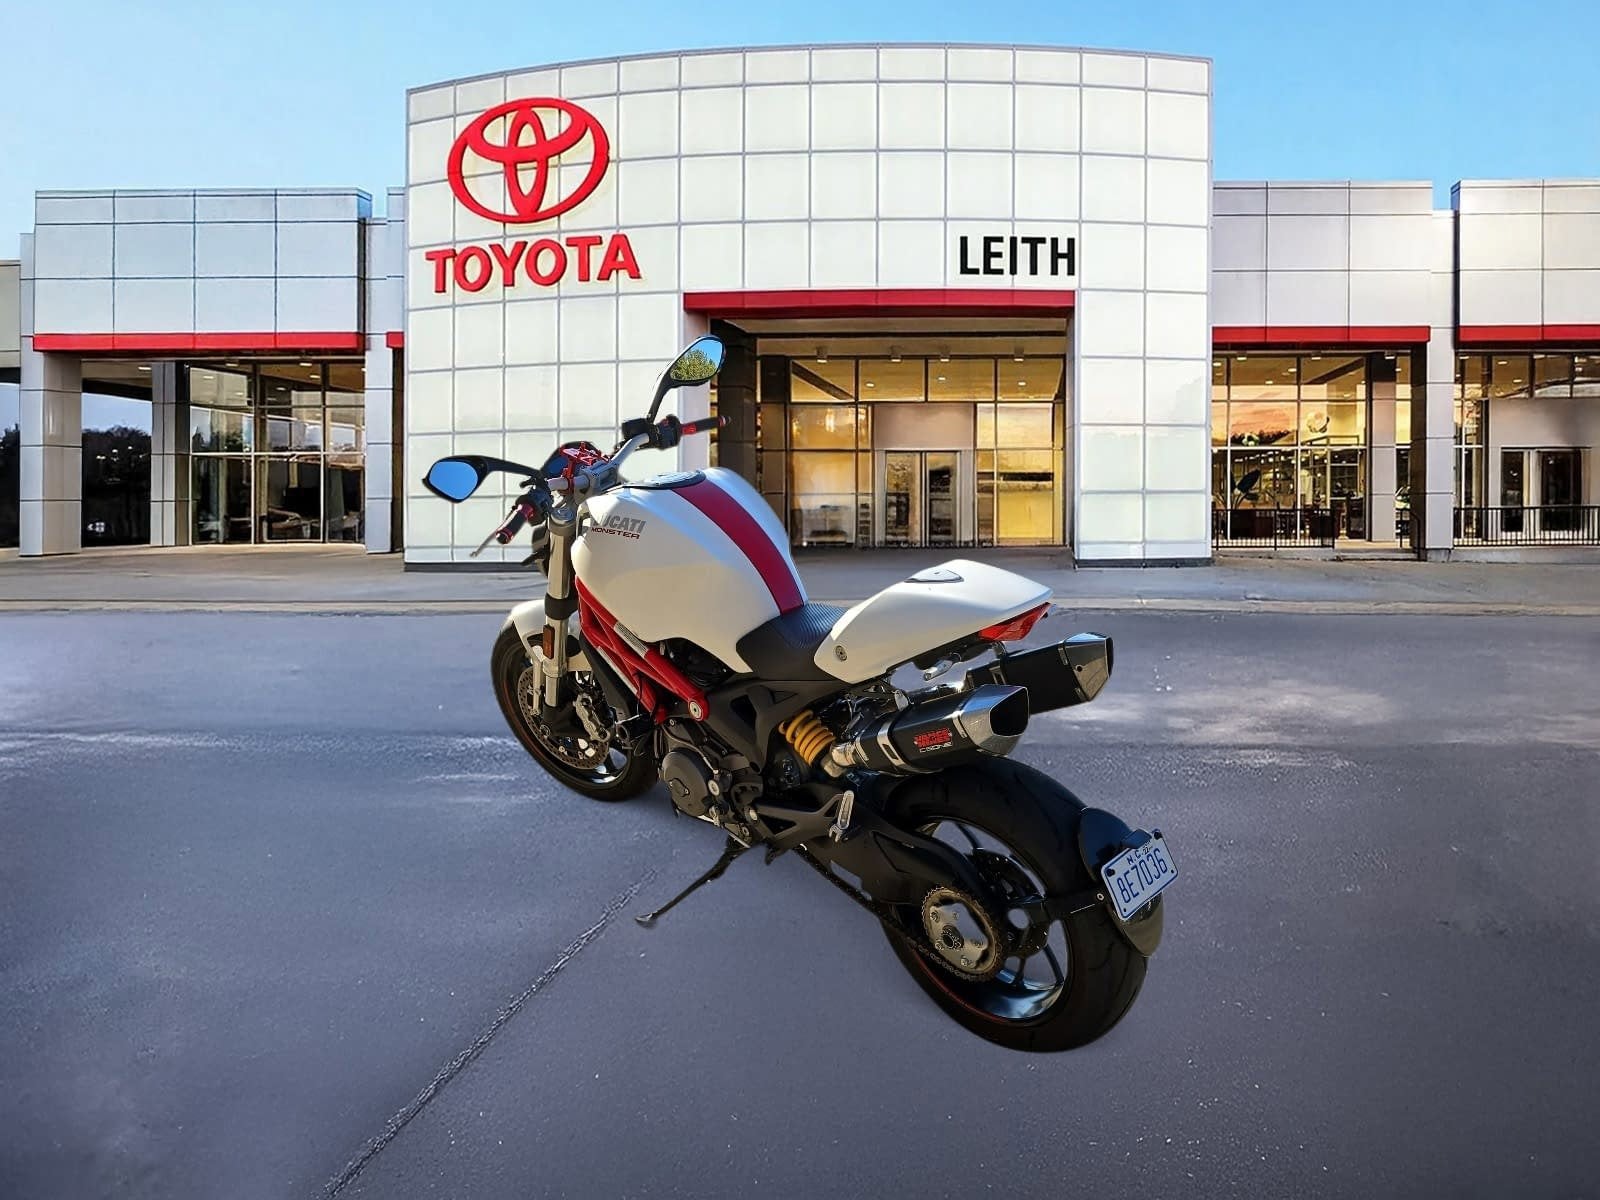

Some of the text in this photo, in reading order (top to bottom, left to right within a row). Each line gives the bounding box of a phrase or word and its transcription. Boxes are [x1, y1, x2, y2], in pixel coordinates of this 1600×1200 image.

[425, 234, 641, 293] TOYOTA
[960, 236, 1075, 276] LEITH
[591, 527, 640, 540] MONSTER
[1116, 848, 1168, 904] 8E7036
